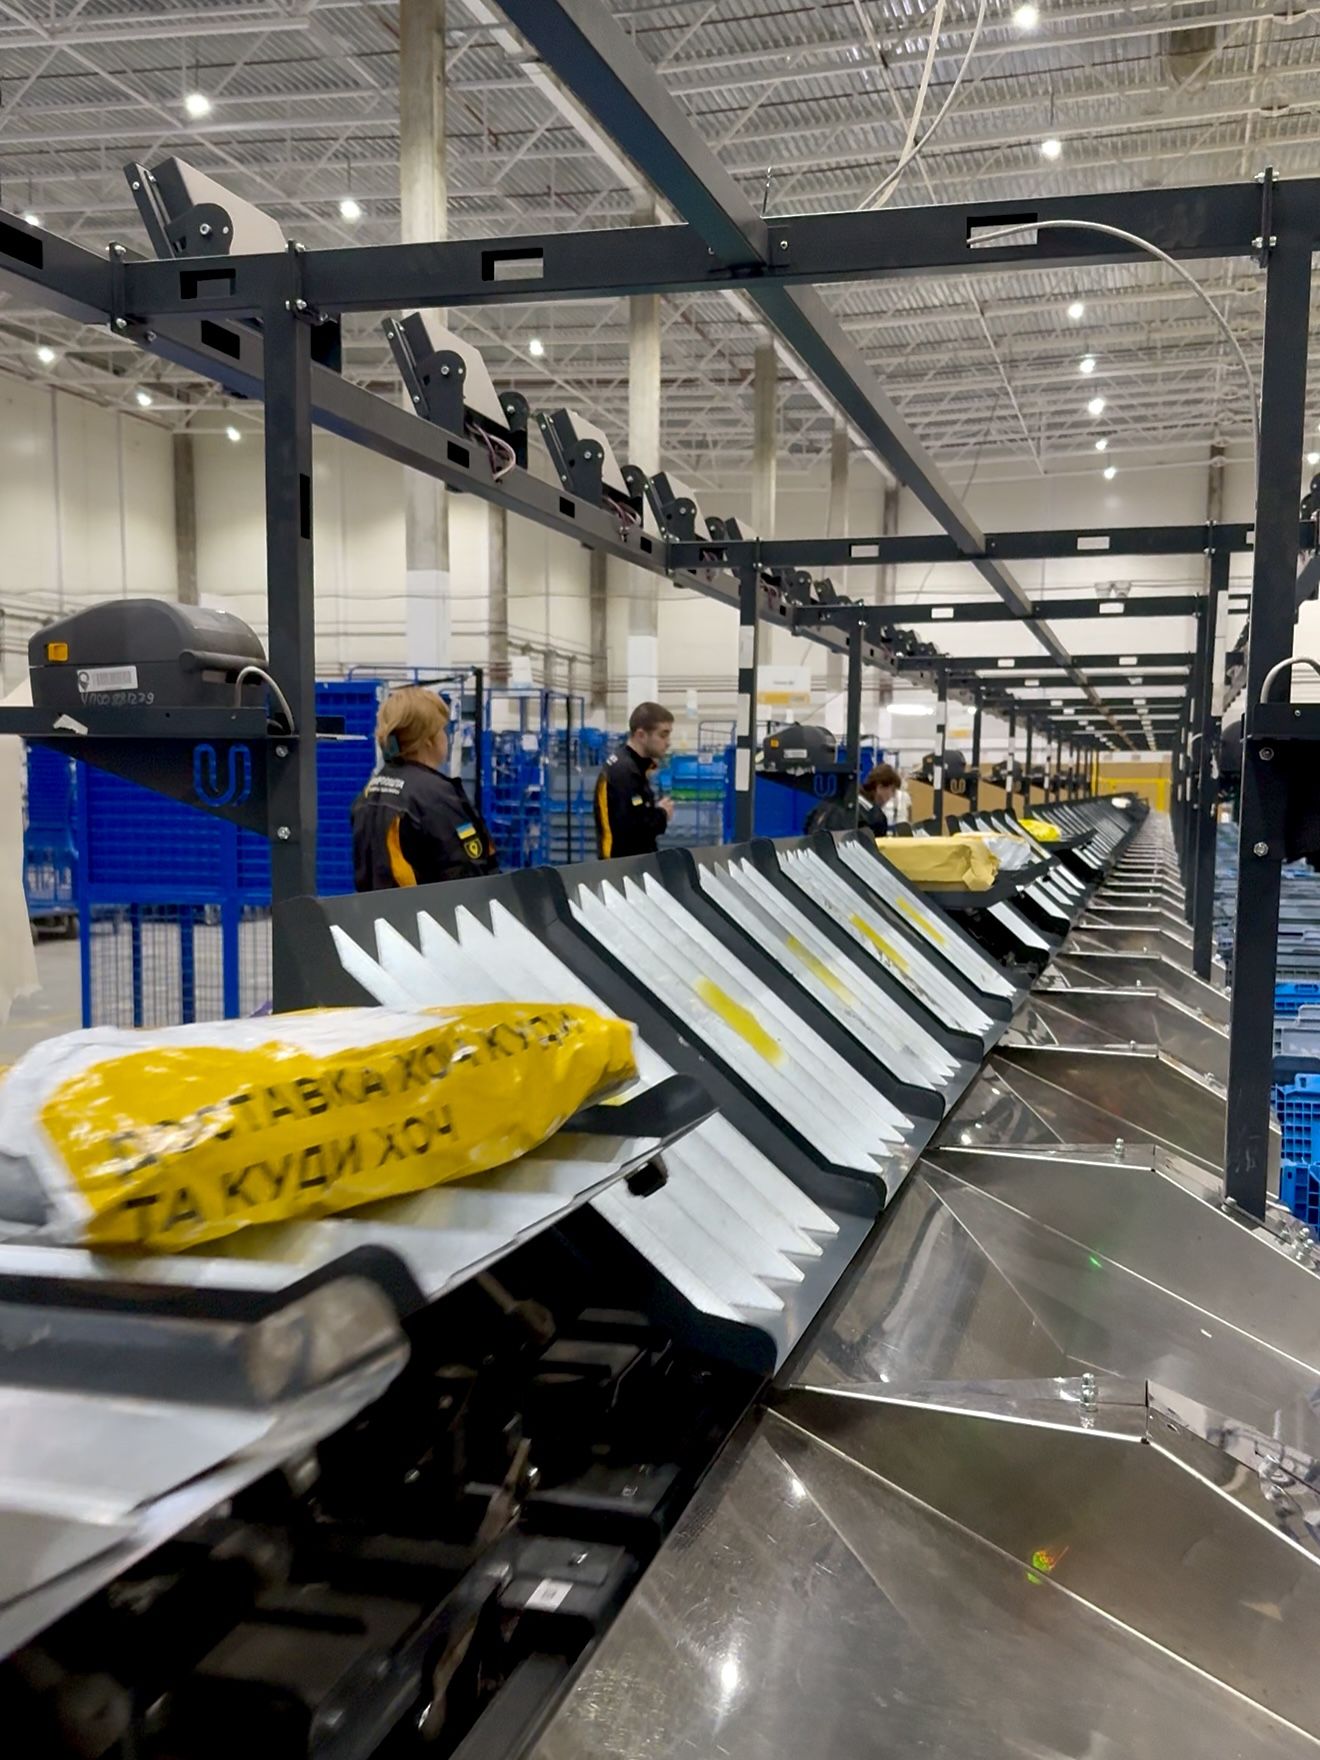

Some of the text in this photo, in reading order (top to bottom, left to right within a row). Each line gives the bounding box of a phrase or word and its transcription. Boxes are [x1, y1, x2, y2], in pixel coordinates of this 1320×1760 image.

[123, 1104, 458, 1239] ТА КУДИ ХОЧ
